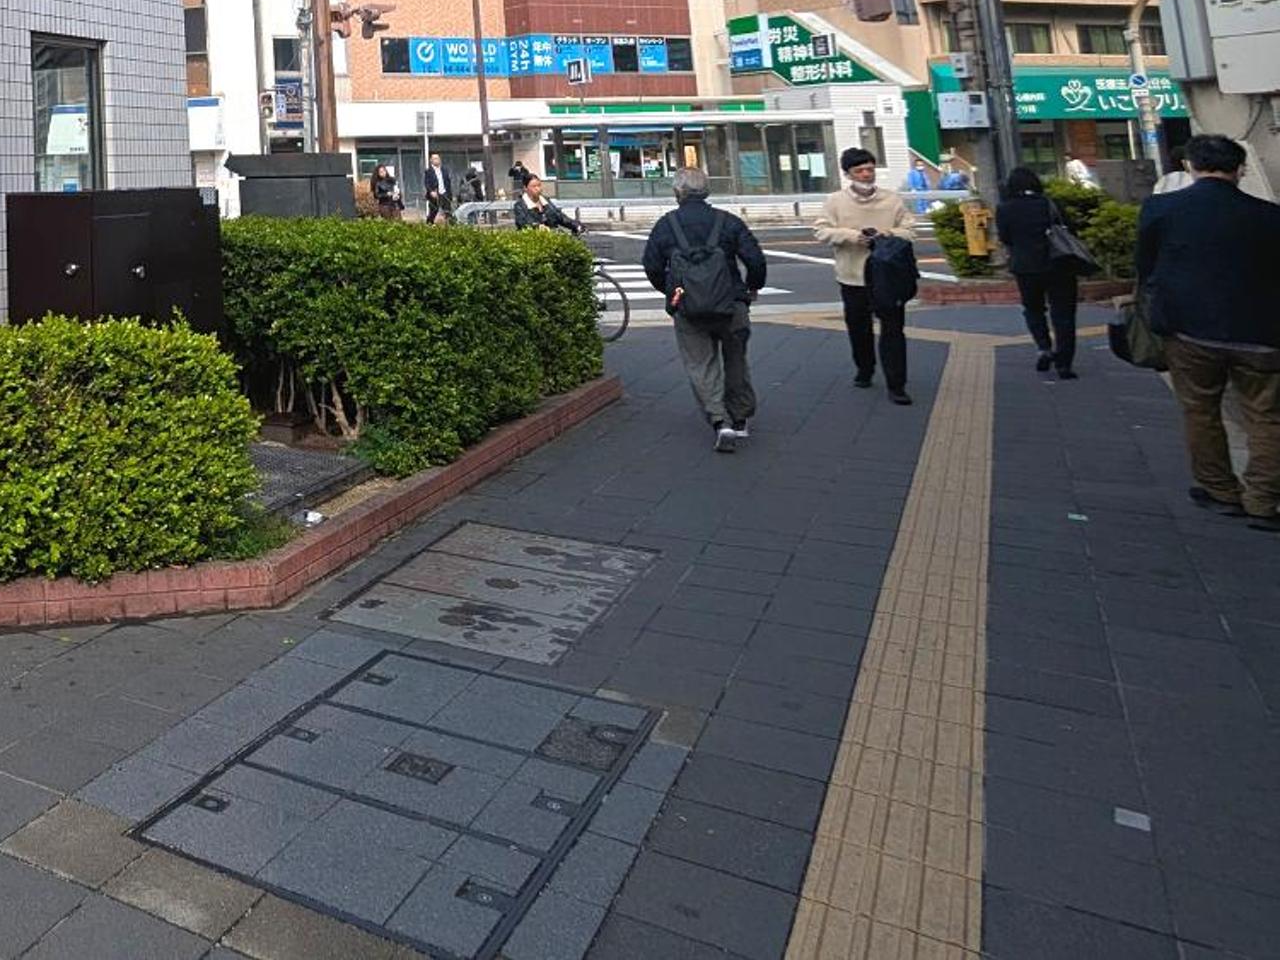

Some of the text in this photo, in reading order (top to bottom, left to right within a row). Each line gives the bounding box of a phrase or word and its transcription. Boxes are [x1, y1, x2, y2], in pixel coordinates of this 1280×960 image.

[777, 43, 814, 63] 精神
[790, 60, 853, 82] 整形外科
